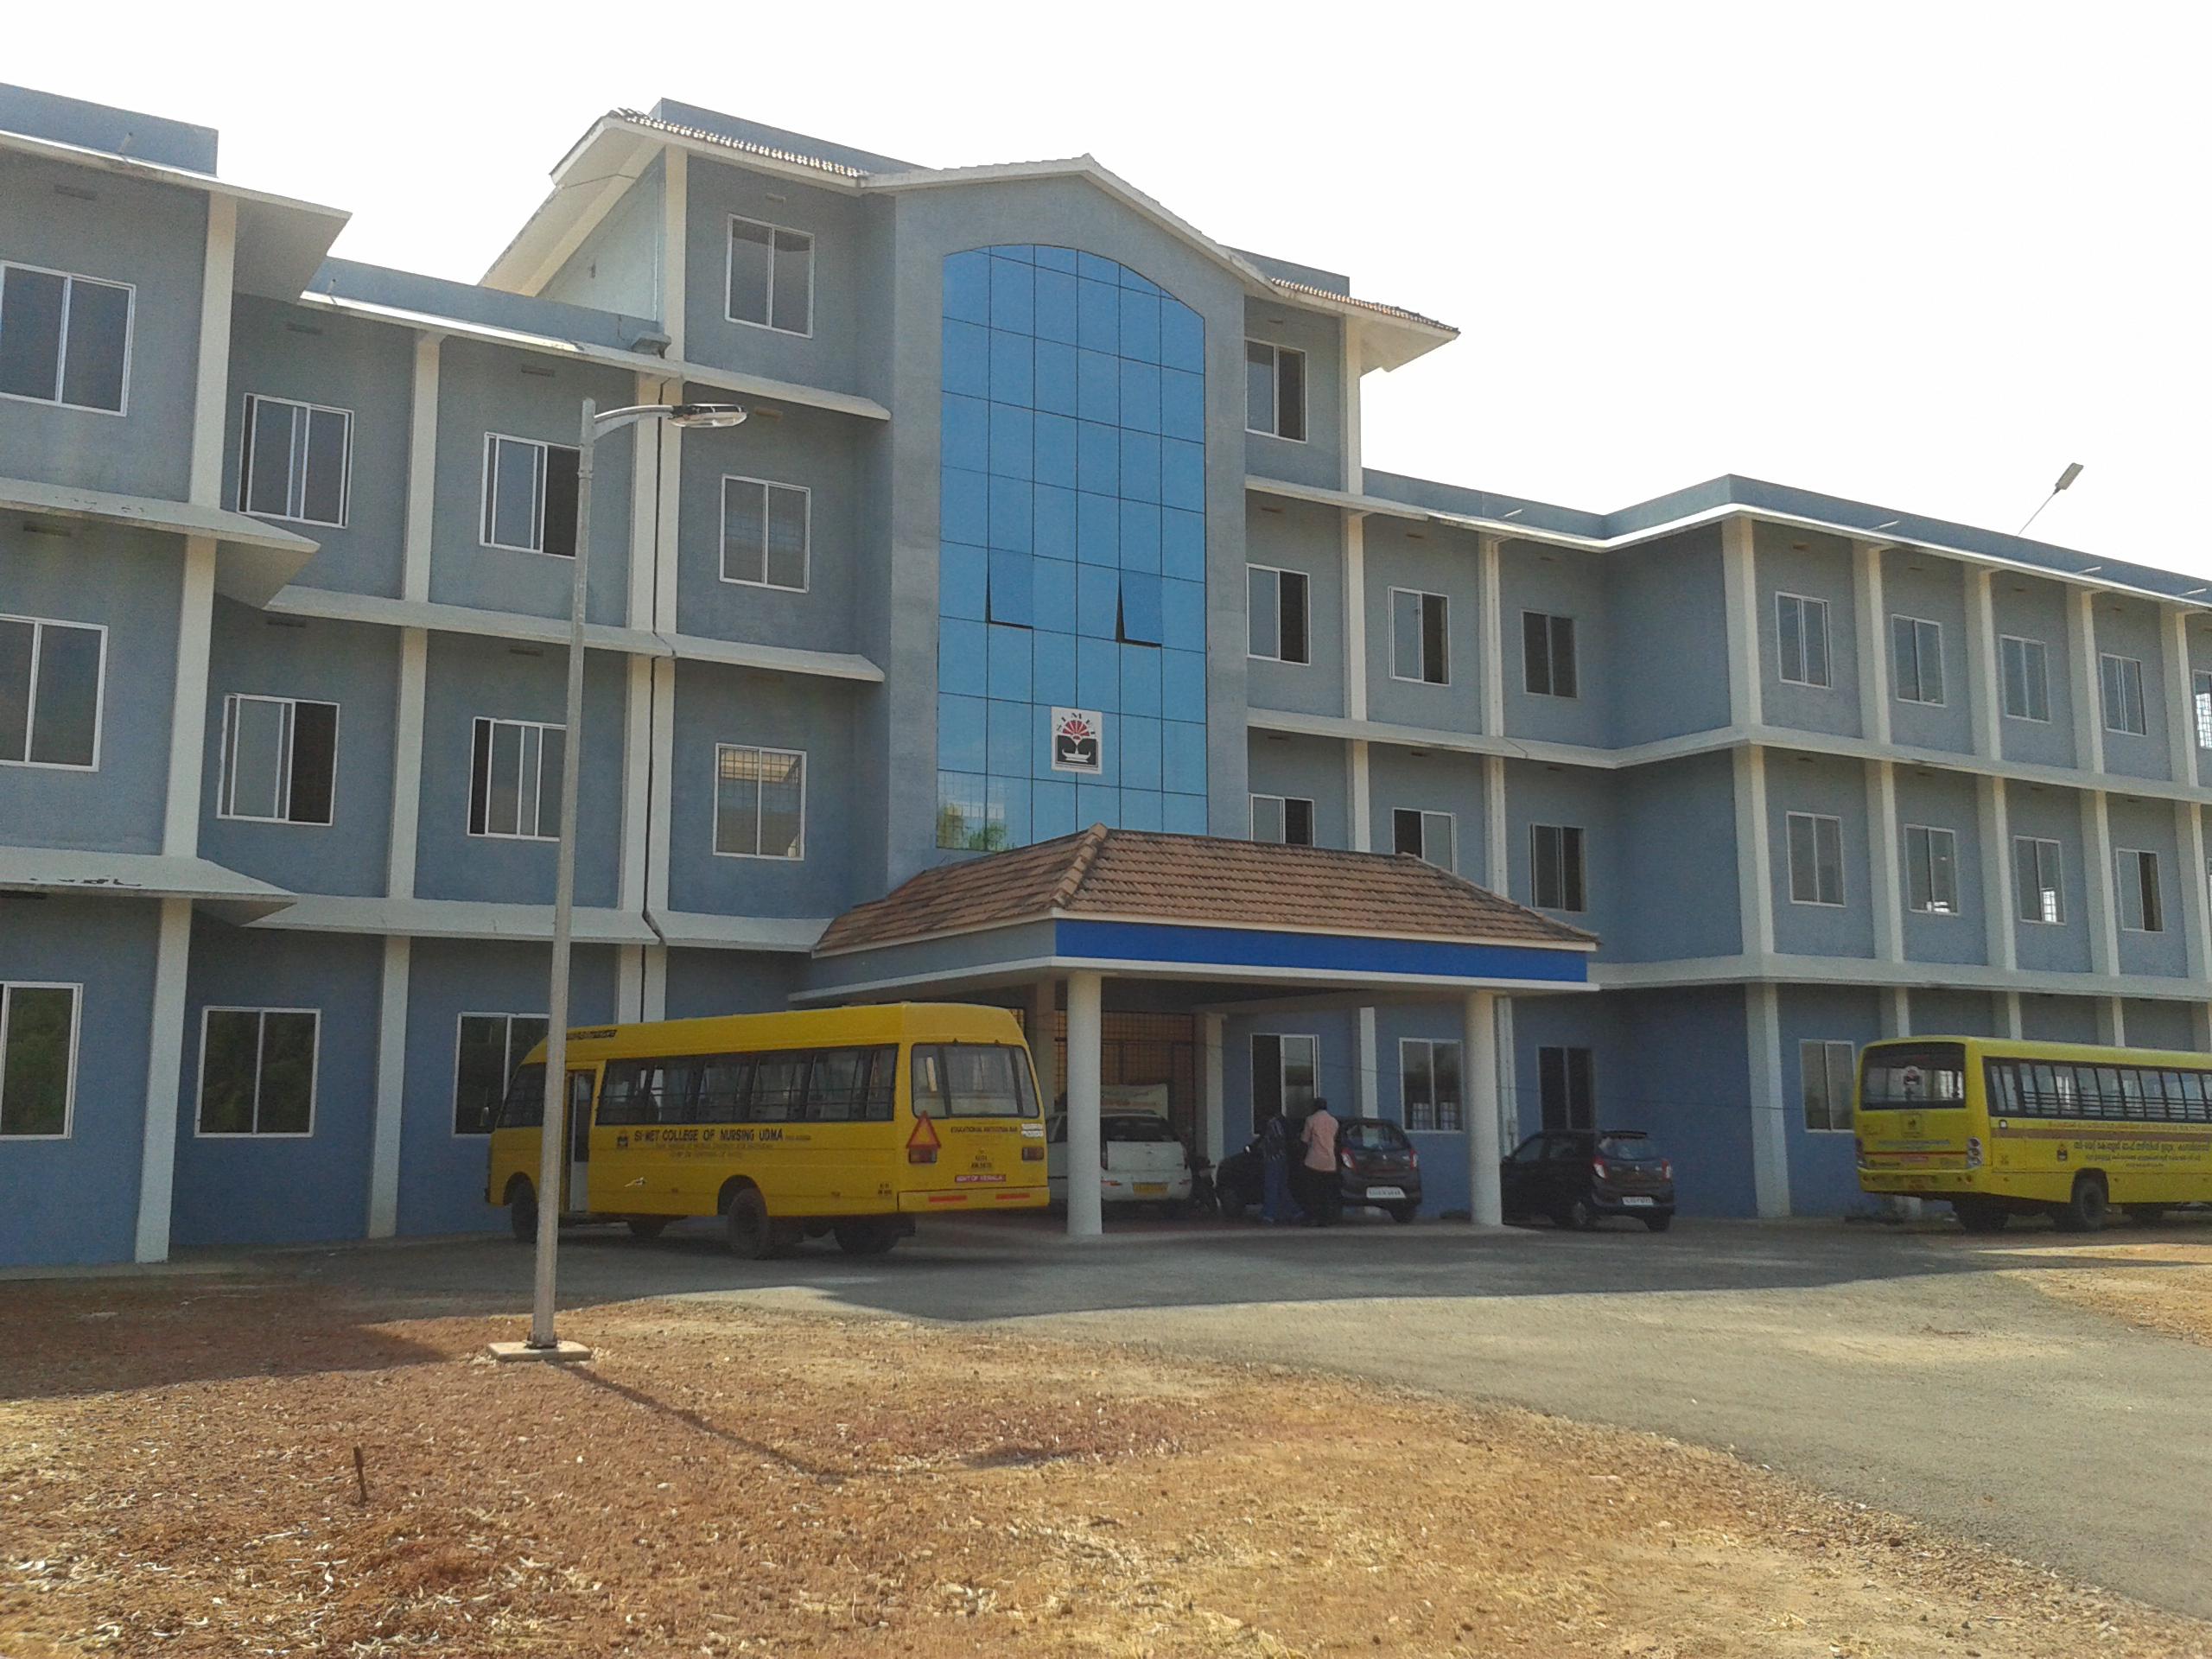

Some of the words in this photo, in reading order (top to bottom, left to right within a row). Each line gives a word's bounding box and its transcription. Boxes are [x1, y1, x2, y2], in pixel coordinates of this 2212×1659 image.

[662, 1128, 698, 1141] COLLEGE
[703, 1129, 715, 1141] OF
[720, 1128, 754, 1141] NURSING
